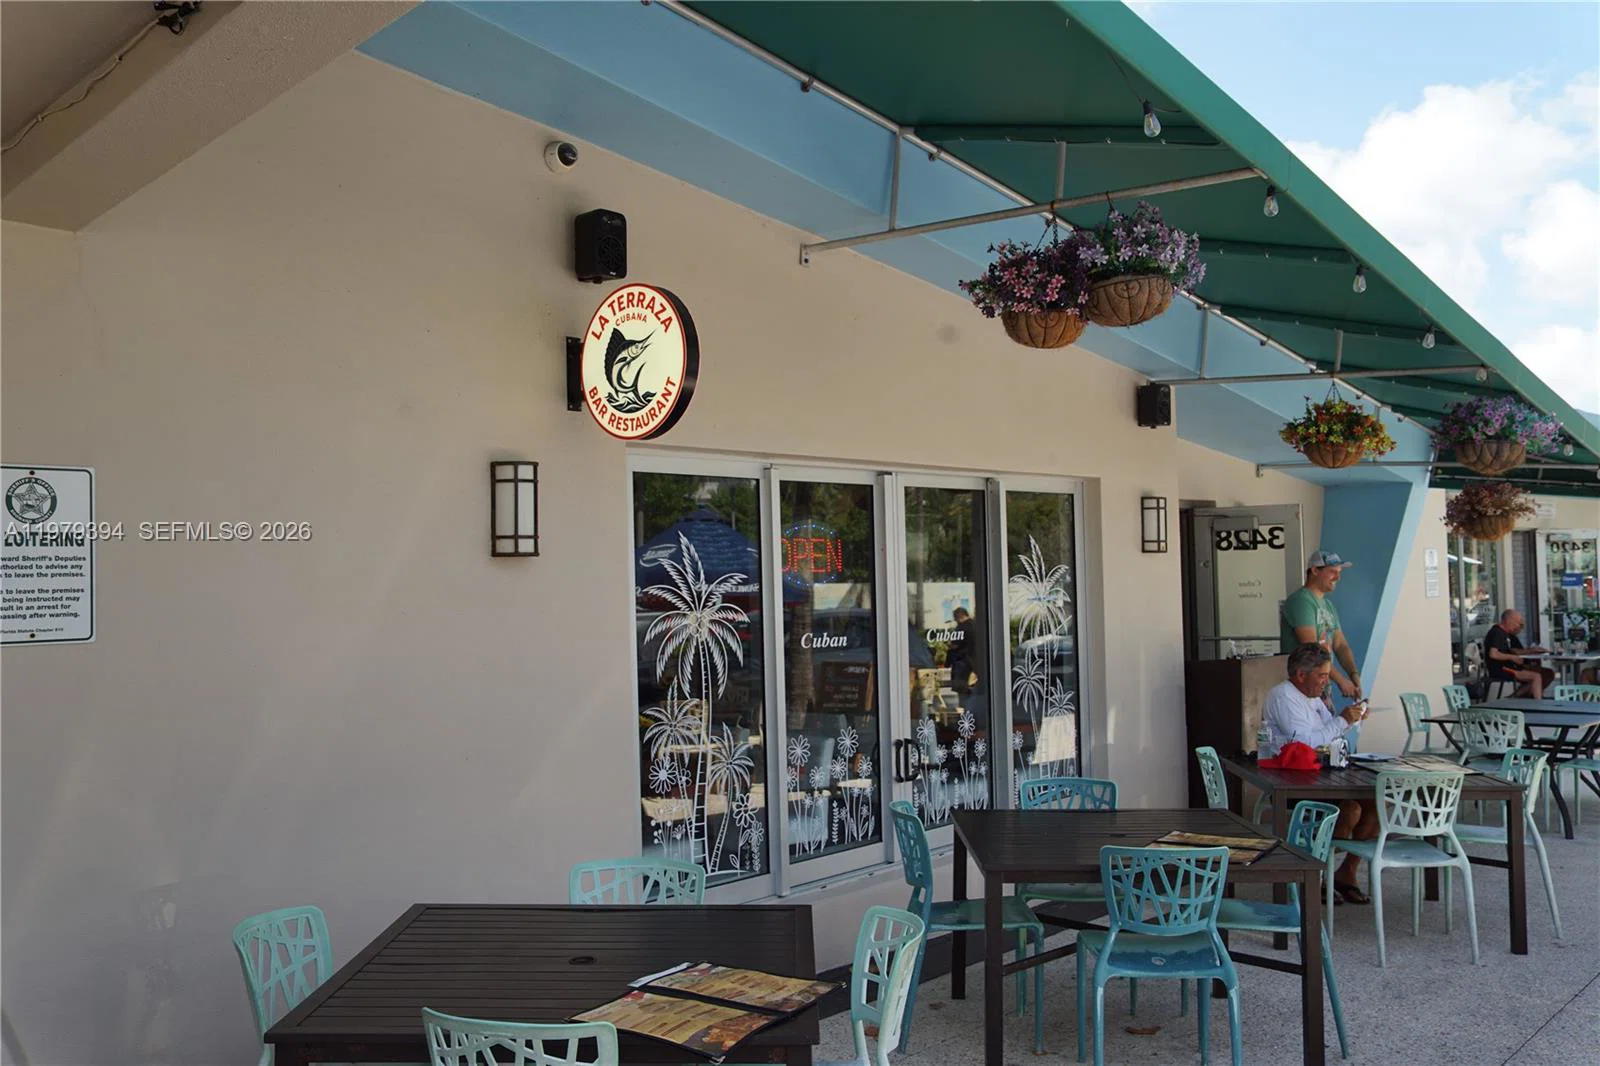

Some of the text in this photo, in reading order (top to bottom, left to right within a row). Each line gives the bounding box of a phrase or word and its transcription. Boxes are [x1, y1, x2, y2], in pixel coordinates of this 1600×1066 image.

[591, 291, 674, 340] LA TERRAZA
[615, 312, 648, 327] CUBANA
[588, 376, 676, 432] BAR RESTAURANT
[4, 531, 85, 547] LOITERING
[780, 537, 843, 573] OPEN
[2, 596, 24, 604] being
[800, 632, 848, 649] Cuban
[926, 627, 965, 643] Cuban
